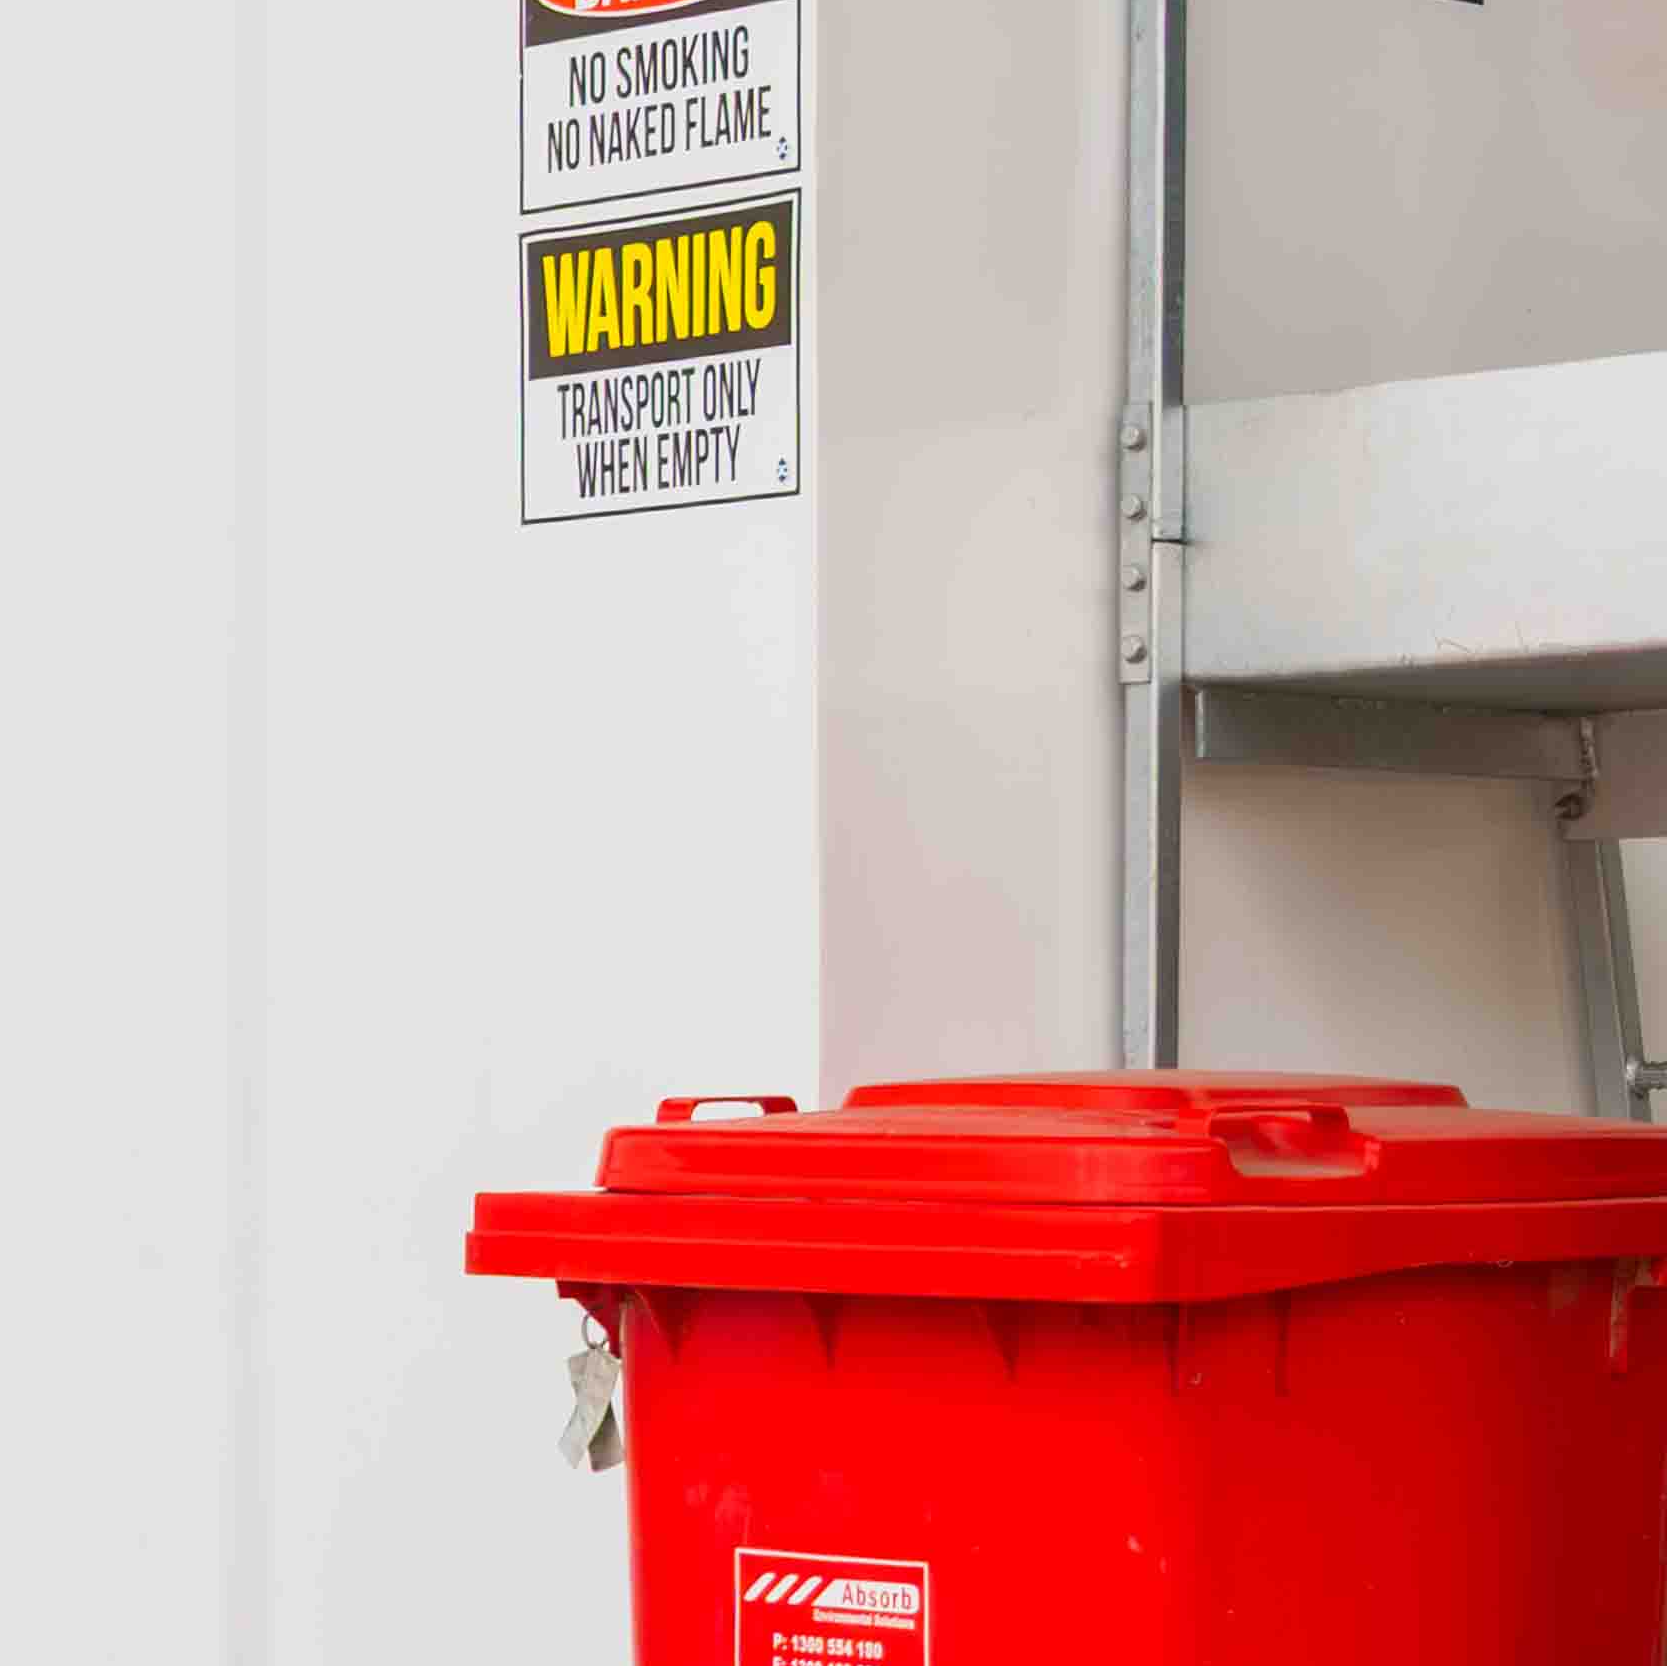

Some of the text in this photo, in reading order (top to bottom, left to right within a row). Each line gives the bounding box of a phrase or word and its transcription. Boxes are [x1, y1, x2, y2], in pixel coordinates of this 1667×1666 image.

[569, 25, 748, 108] NO SMOKING
[548, 85, 772, 174] NO NAKED FLAME
[542, 221, 776, 358] WARNING
[557, 358, 761, 440] TRANSPORT ONLY
[576, 423, 740, 499] WHEN EMPTY
[842, 1583, 912, 1609] Absorb
